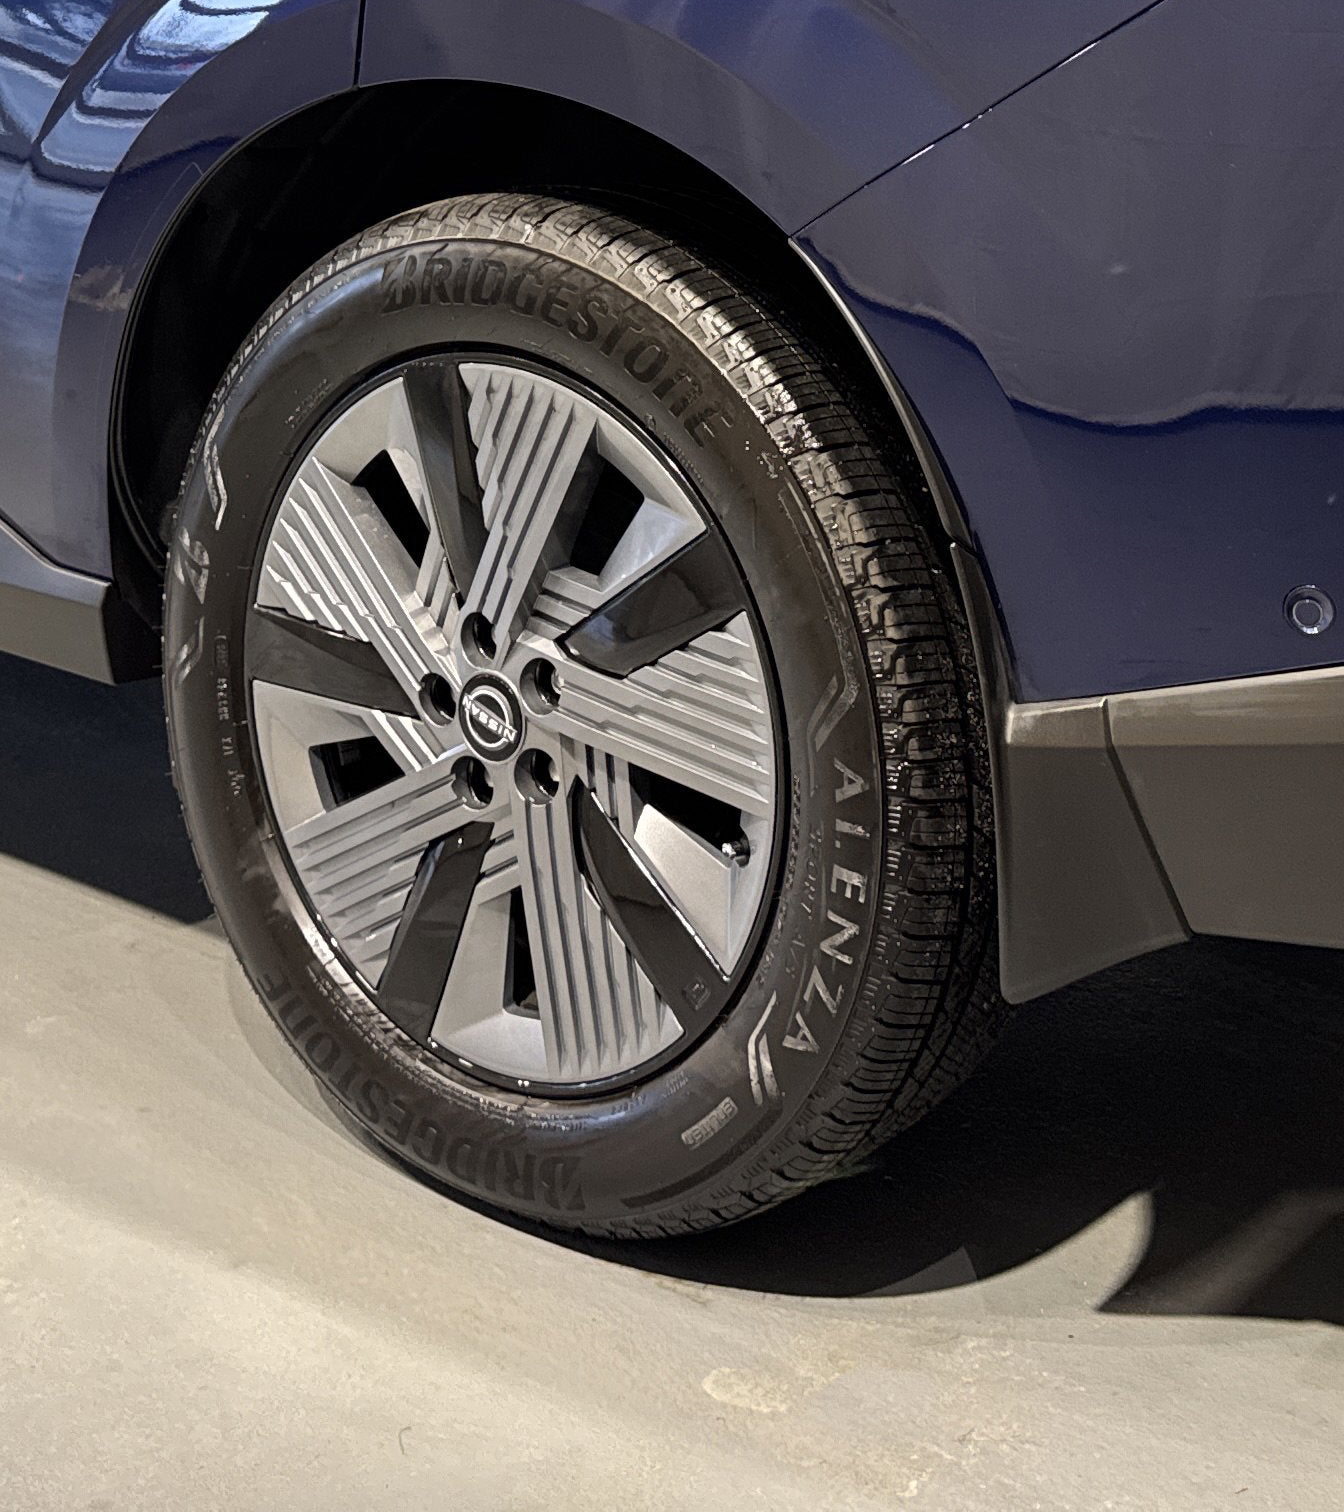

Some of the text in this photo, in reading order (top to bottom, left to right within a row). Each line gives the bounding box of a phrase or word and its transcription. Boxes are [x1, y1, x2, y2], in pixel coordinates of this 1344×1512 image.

[380, 253, 736, 449] BRIDGESTONE
[462, 692, 518, 744] NISSAN
[781, 757, 870, 1054] ALENZA
